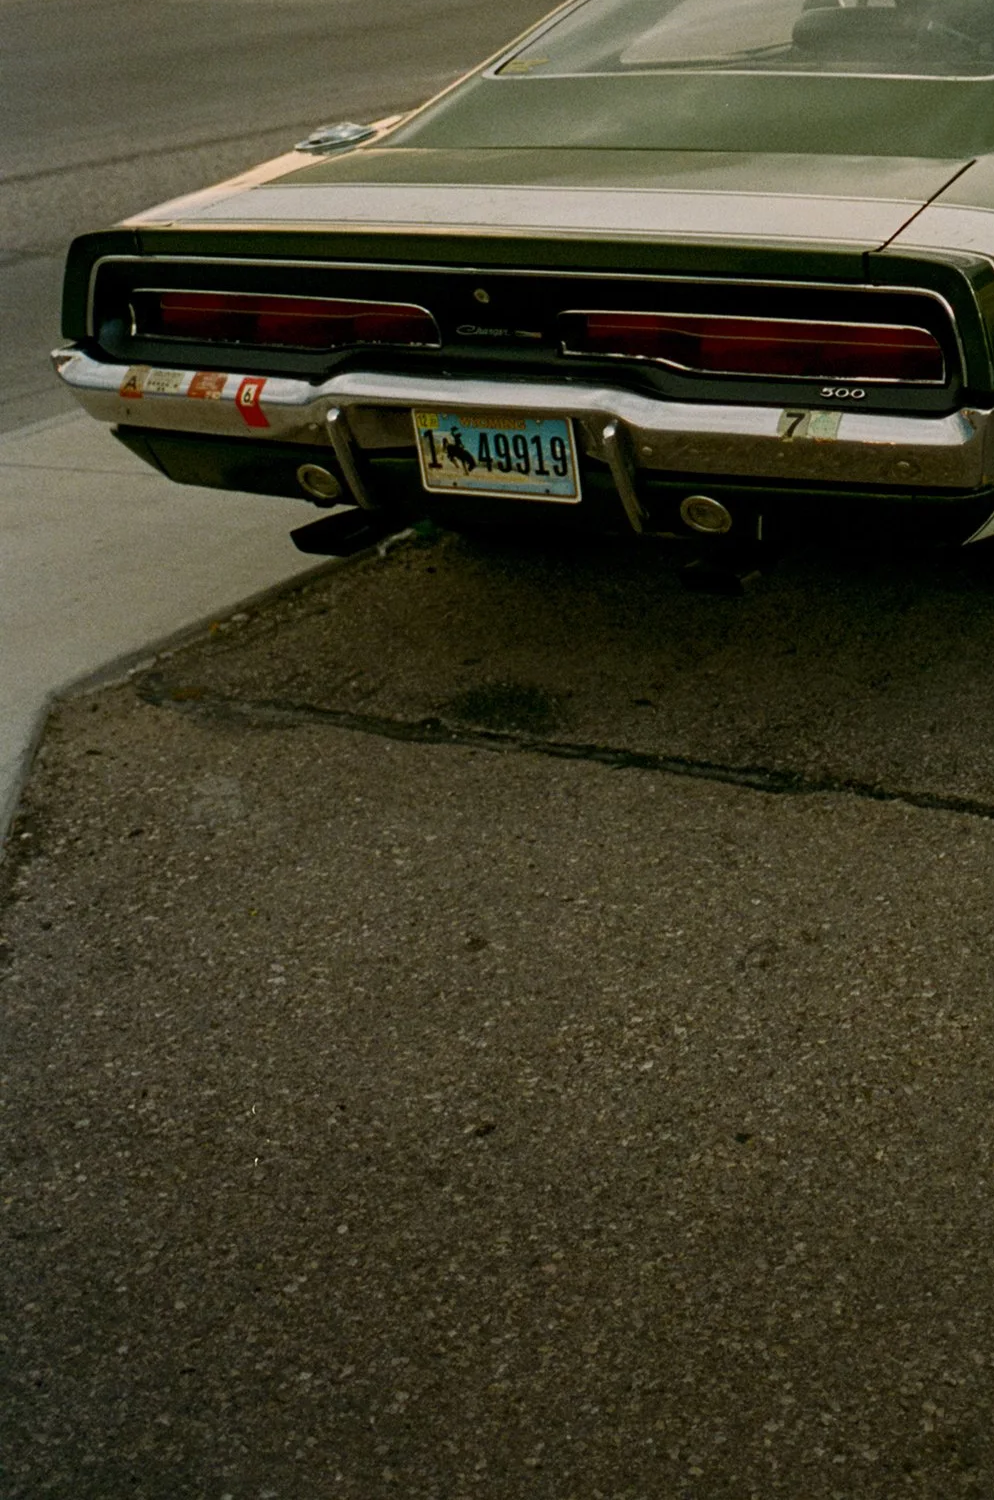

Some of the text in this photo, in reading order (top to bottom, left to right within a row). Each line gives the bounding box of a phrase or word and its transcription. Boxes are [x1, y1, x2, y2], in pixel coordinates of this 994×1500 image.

[124, 375, 137, 390] A
[243, 389, 252, 404] 6
[820, 387, 865, 399] 500
[459, 417, 526, 430] WYOMING
[786, 412, 806, 438] 7
[423, 429, 568, 477] 1 49919
